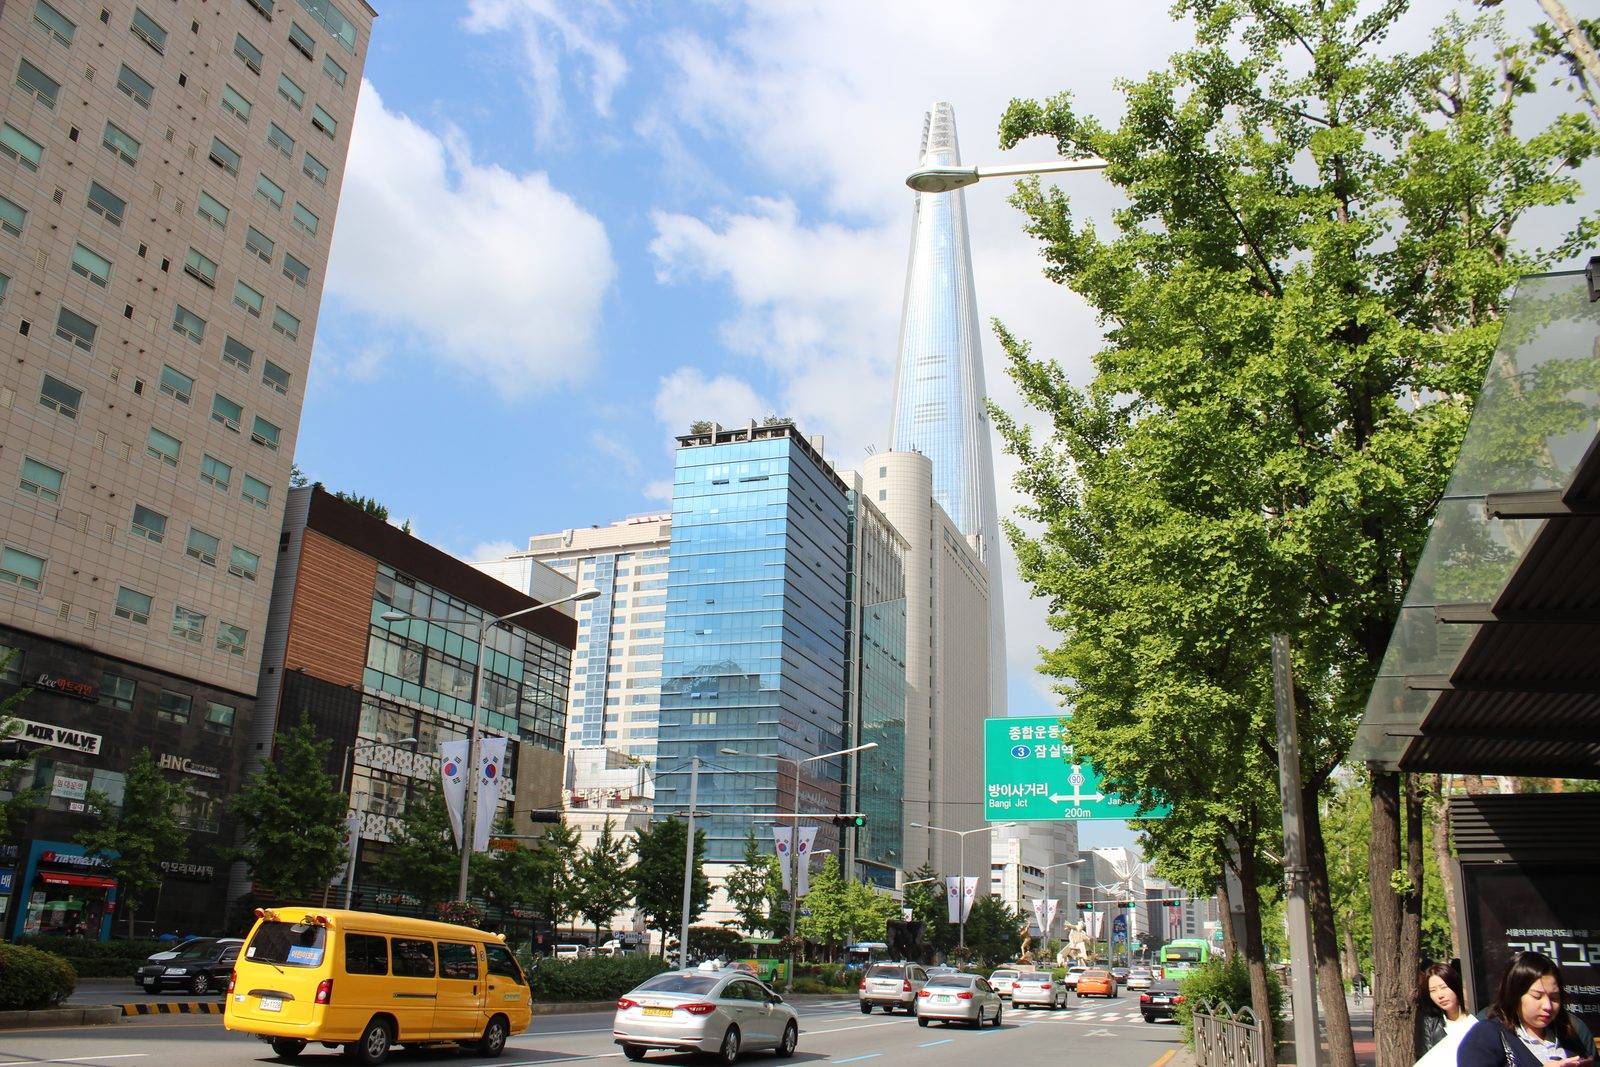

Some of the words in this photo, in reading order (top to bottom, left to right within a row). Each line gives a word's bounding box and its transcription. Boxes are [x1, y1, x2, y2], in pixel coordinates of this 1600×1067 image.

[26, 724, 54, 741] MIR
[57, 730, 97, 749] VALVE
[1035, 744, 1074, 758] 잠실역
[161, 754, 191, 773] HNC
[988, 783, 1048, 797] 방이사거리
[989, 799, 1011, 809] Bangi
[1015, 799, 1028, 807] Jct
[1065, 808, 1091, 818] 200m
